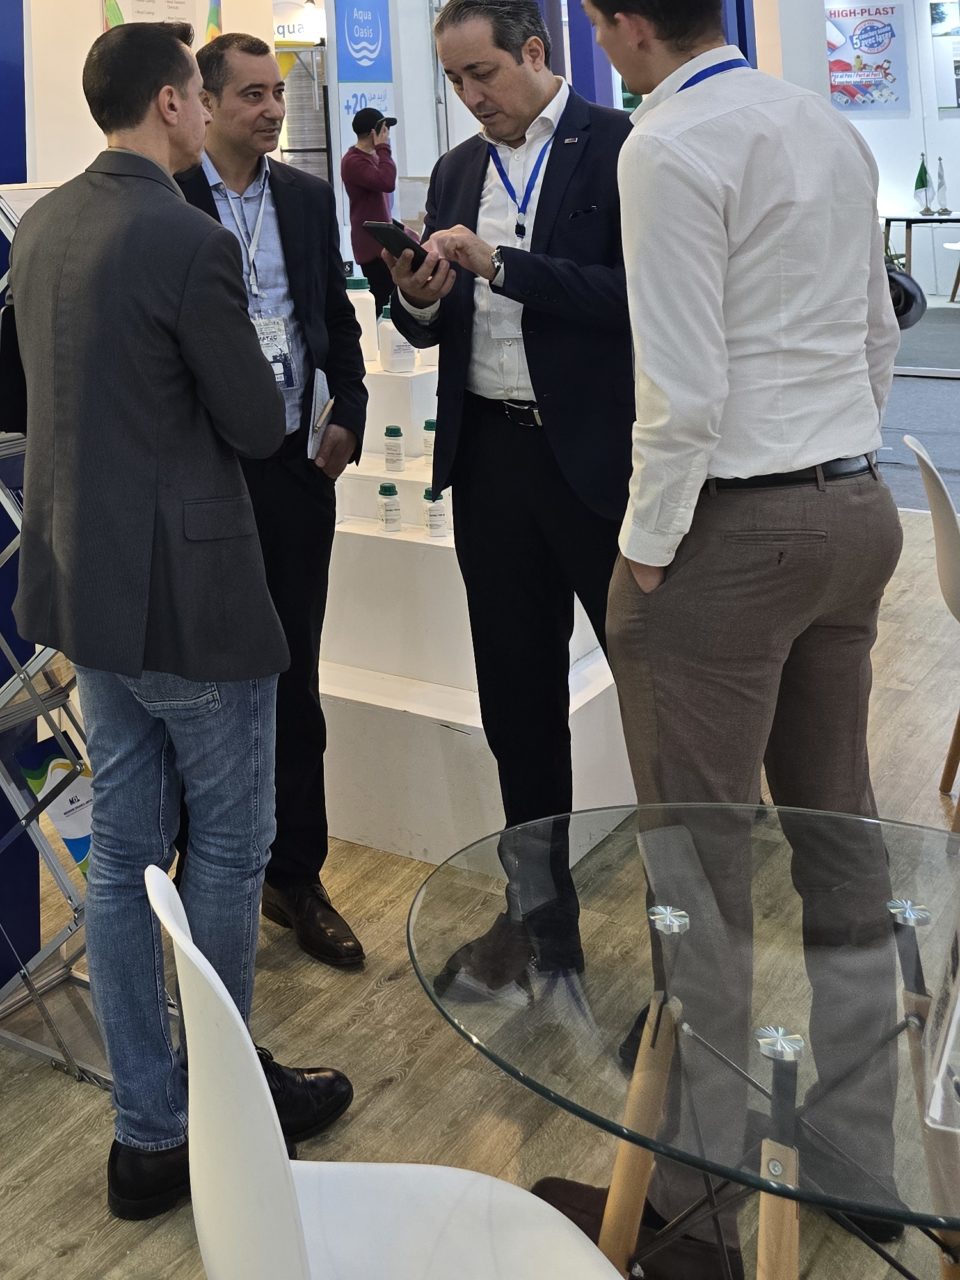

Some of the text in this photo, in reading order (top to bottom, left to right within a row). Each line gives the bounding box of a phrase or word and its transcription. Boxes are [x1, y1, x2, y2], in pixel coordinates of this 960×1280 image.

[353, 7, 372, 23] Aqua
[829, 6, 896, 18] HIGH-PLAST
[273, 23, 305, 39] qua
[353, 24, 374, 39] Oasis
[344, 93, 367, 115] +20
